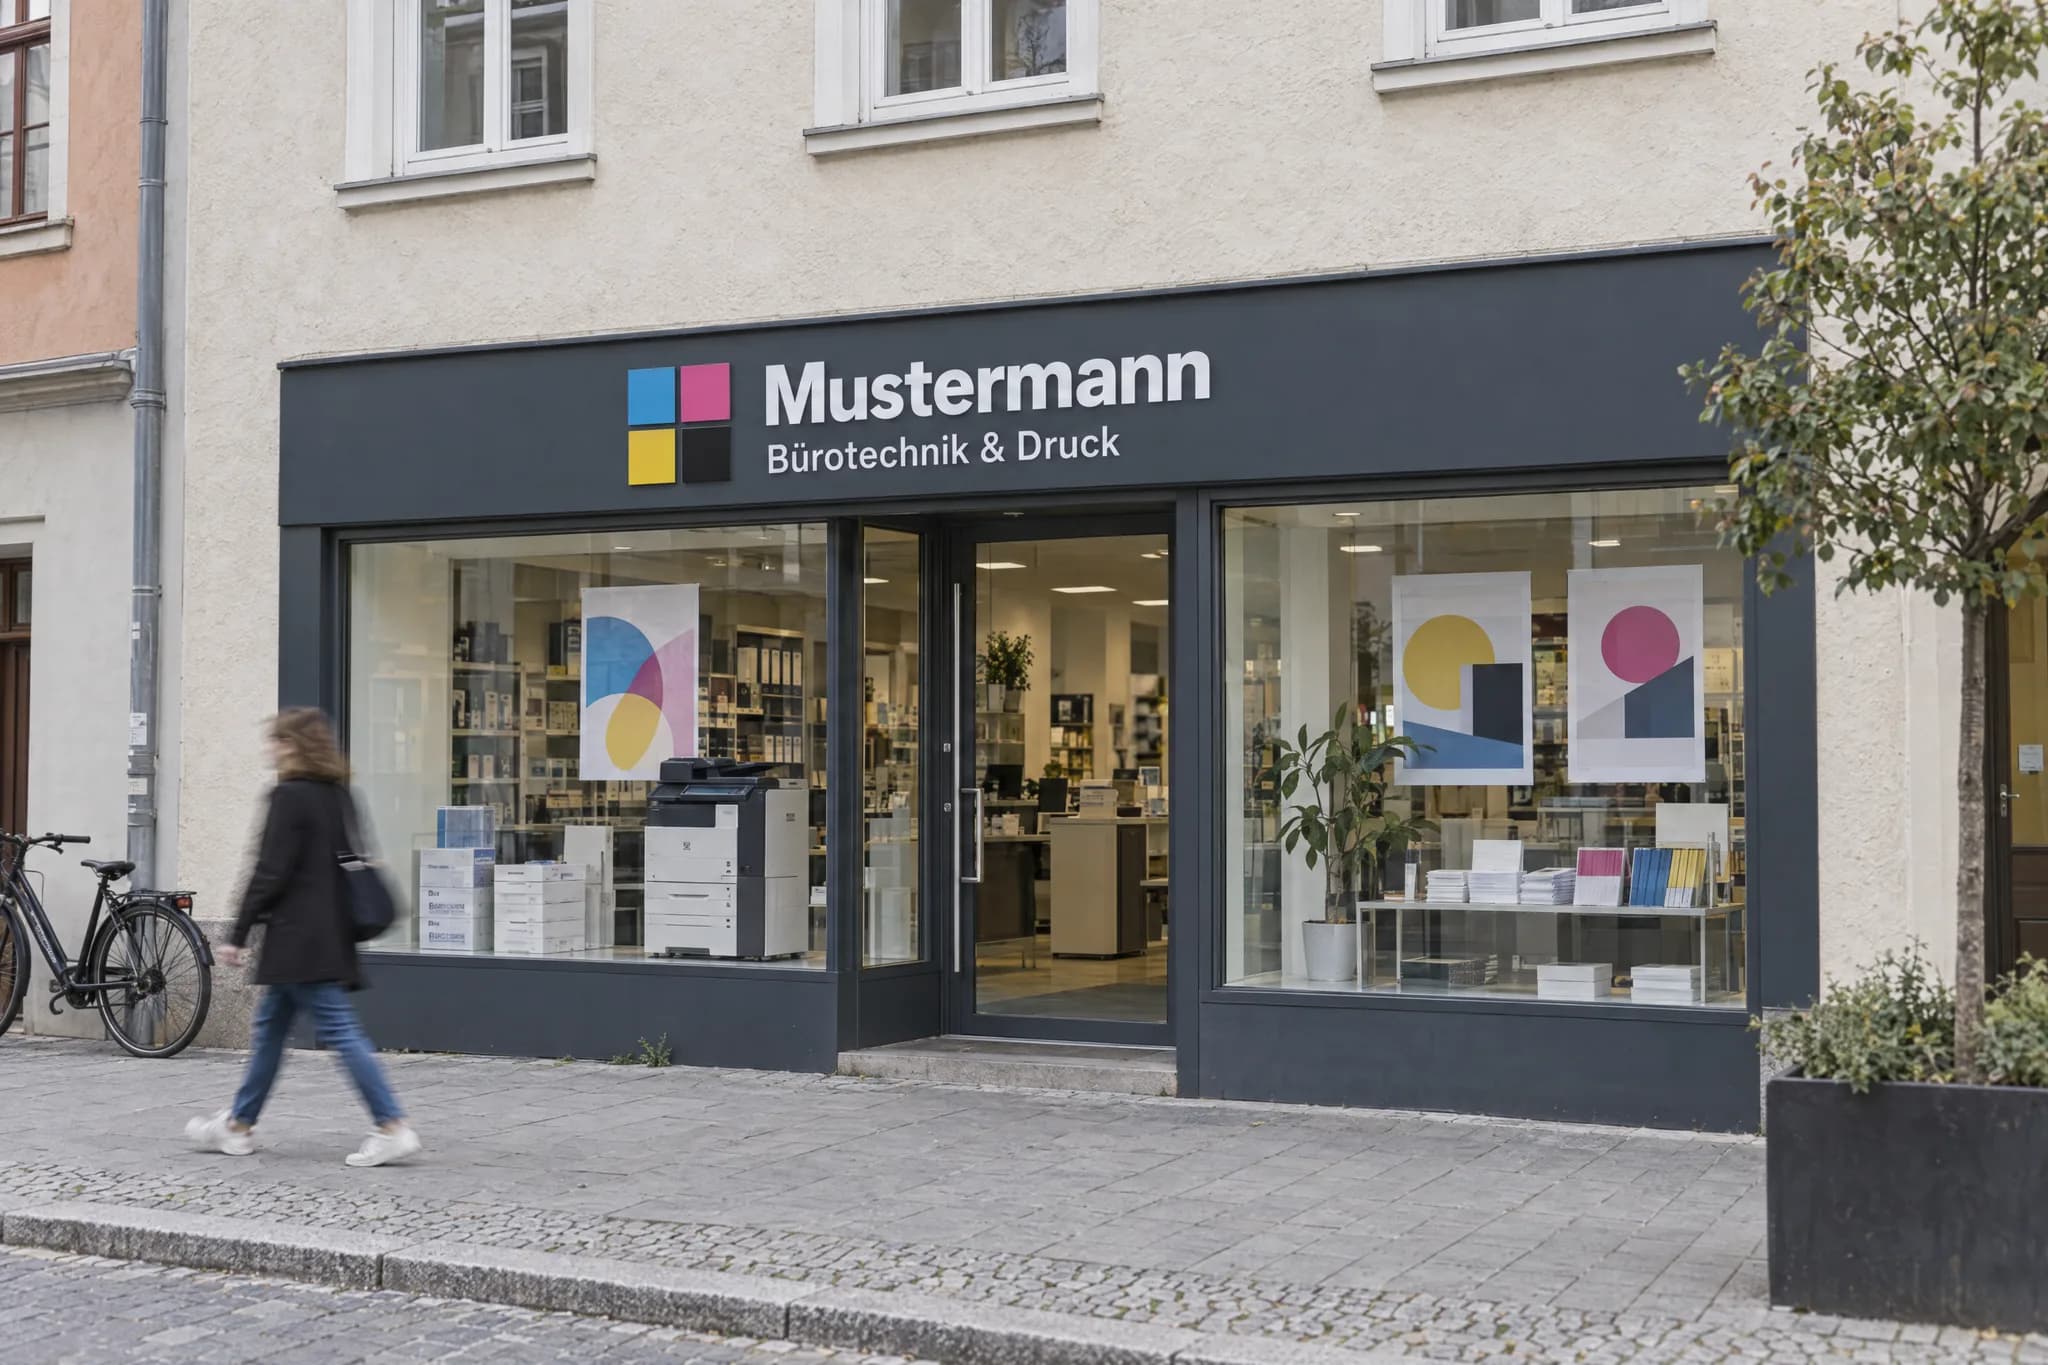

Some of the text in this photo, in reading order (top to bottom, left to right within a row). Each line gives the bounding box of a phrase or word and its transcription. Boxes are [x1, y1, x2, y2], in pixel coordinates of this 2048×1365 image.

[765, 350, 1211, 427] Mustermann
[767, 425, 1121, 475] Bürotechnik & Druck
